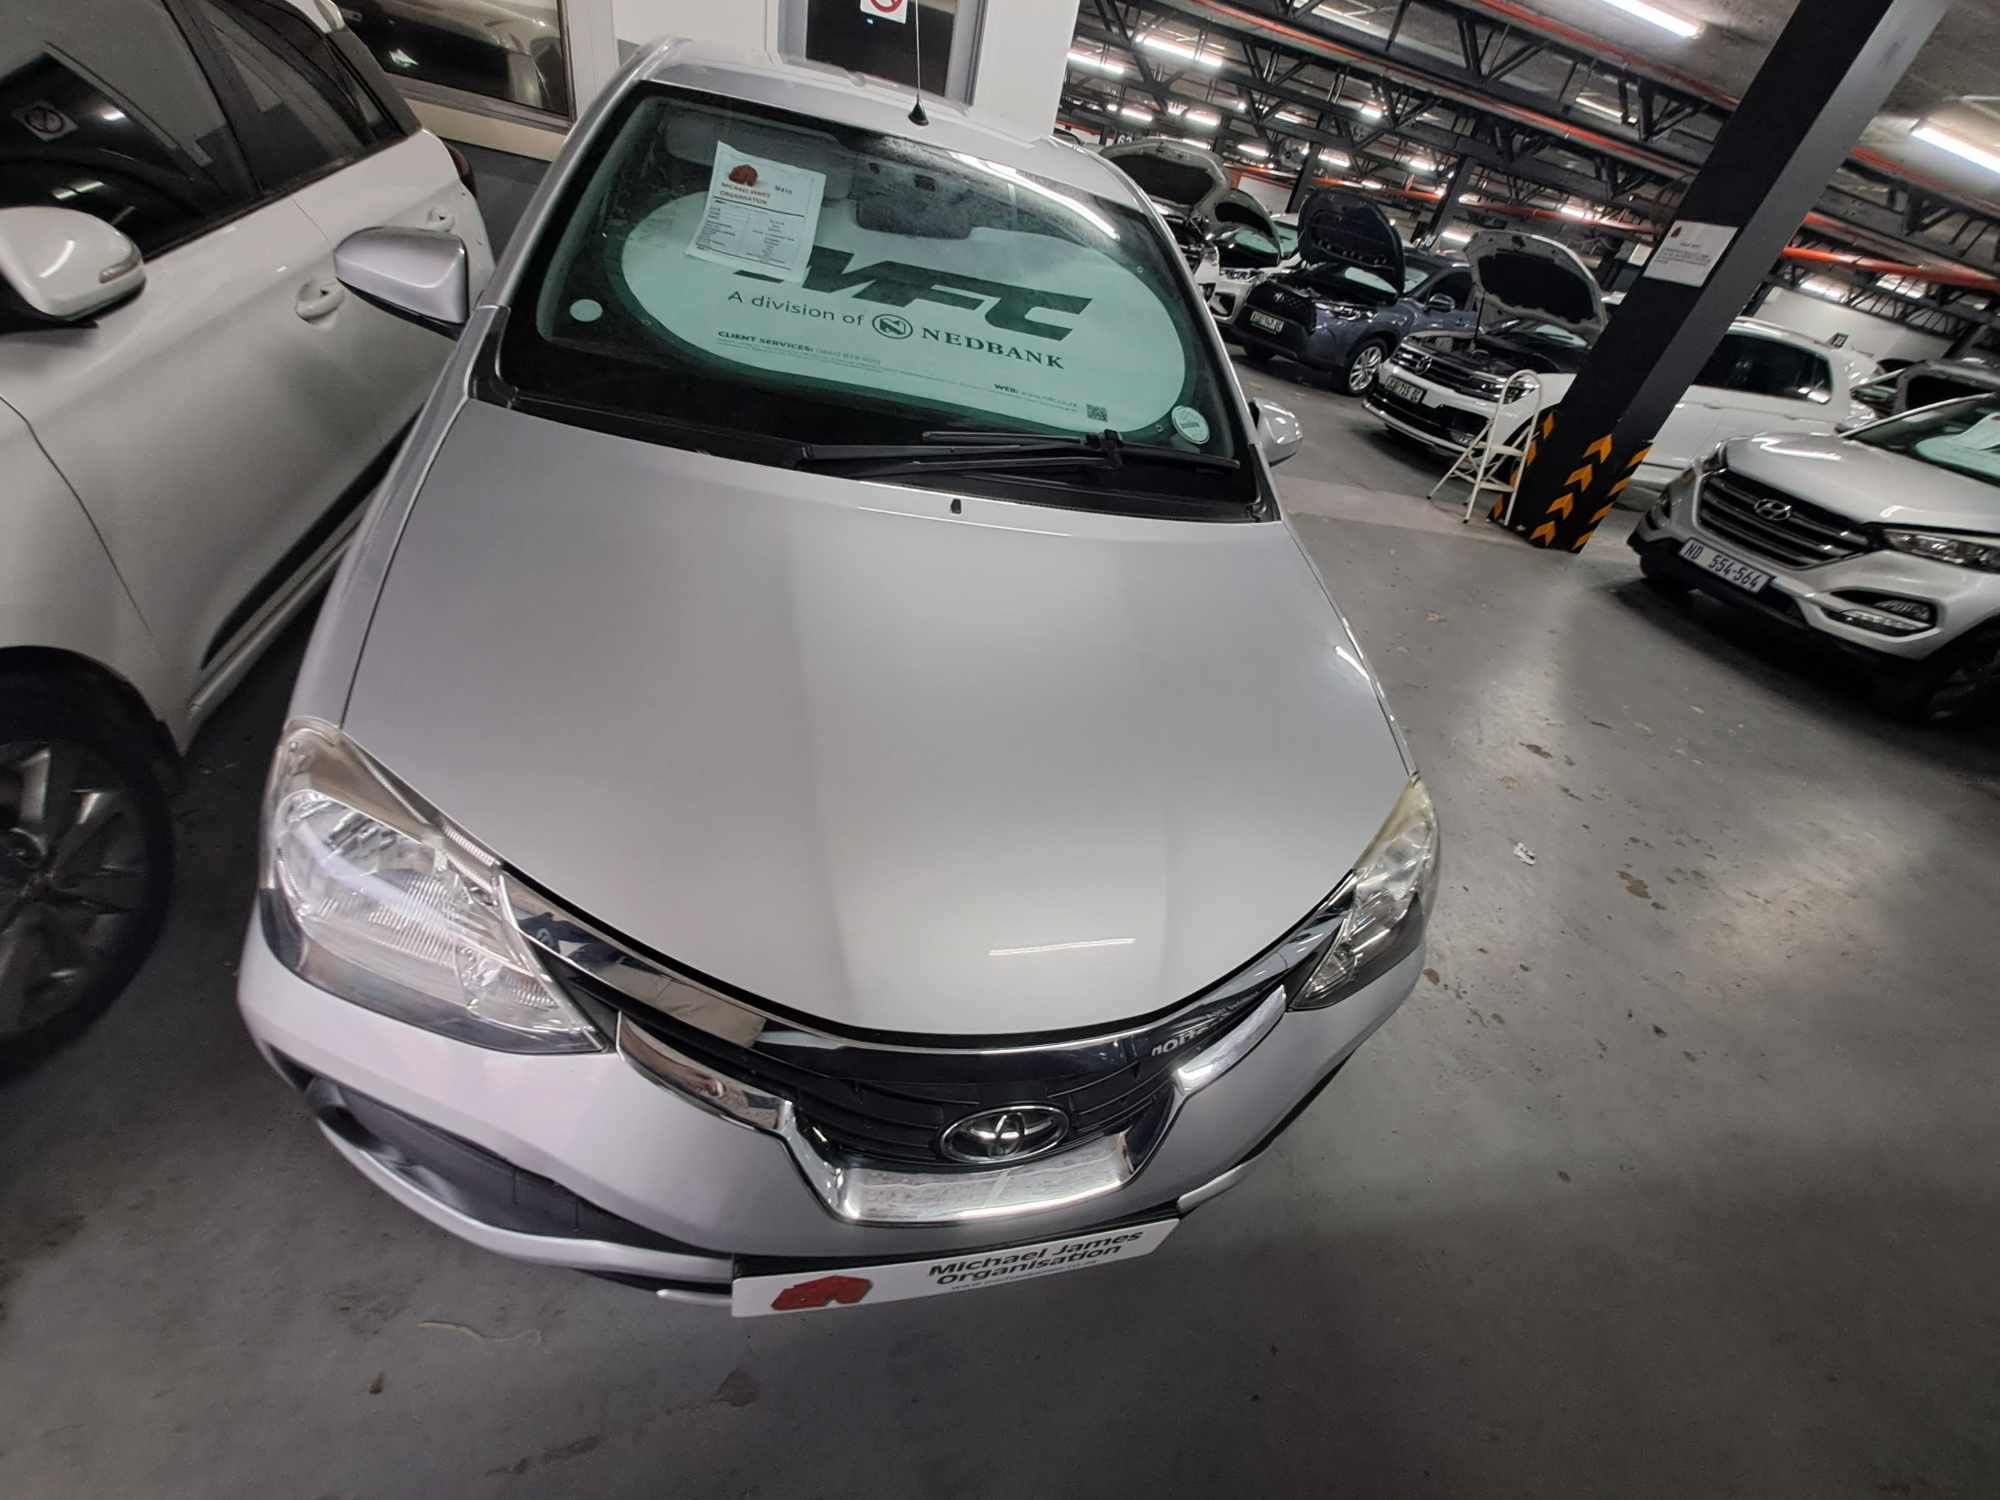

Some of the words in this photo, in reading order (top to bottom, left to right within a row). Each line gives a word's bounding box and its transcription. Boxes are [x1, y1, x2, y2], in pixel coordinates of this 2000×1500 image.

[727, 290, 743, 303] A
[751, 294, 835, 321] division
[842, 313, 865, 326] of
[718, 330, 757, 342] CLIENT
[920, 326, 1065, 369] NEDBANK
[1684, 542, 1704, 559] ND
[928, 1247, 1047, 1278] Michael
[1052, 1230, 1144, 1257] James
[936, 1245, 1121, 1286] Organisation
